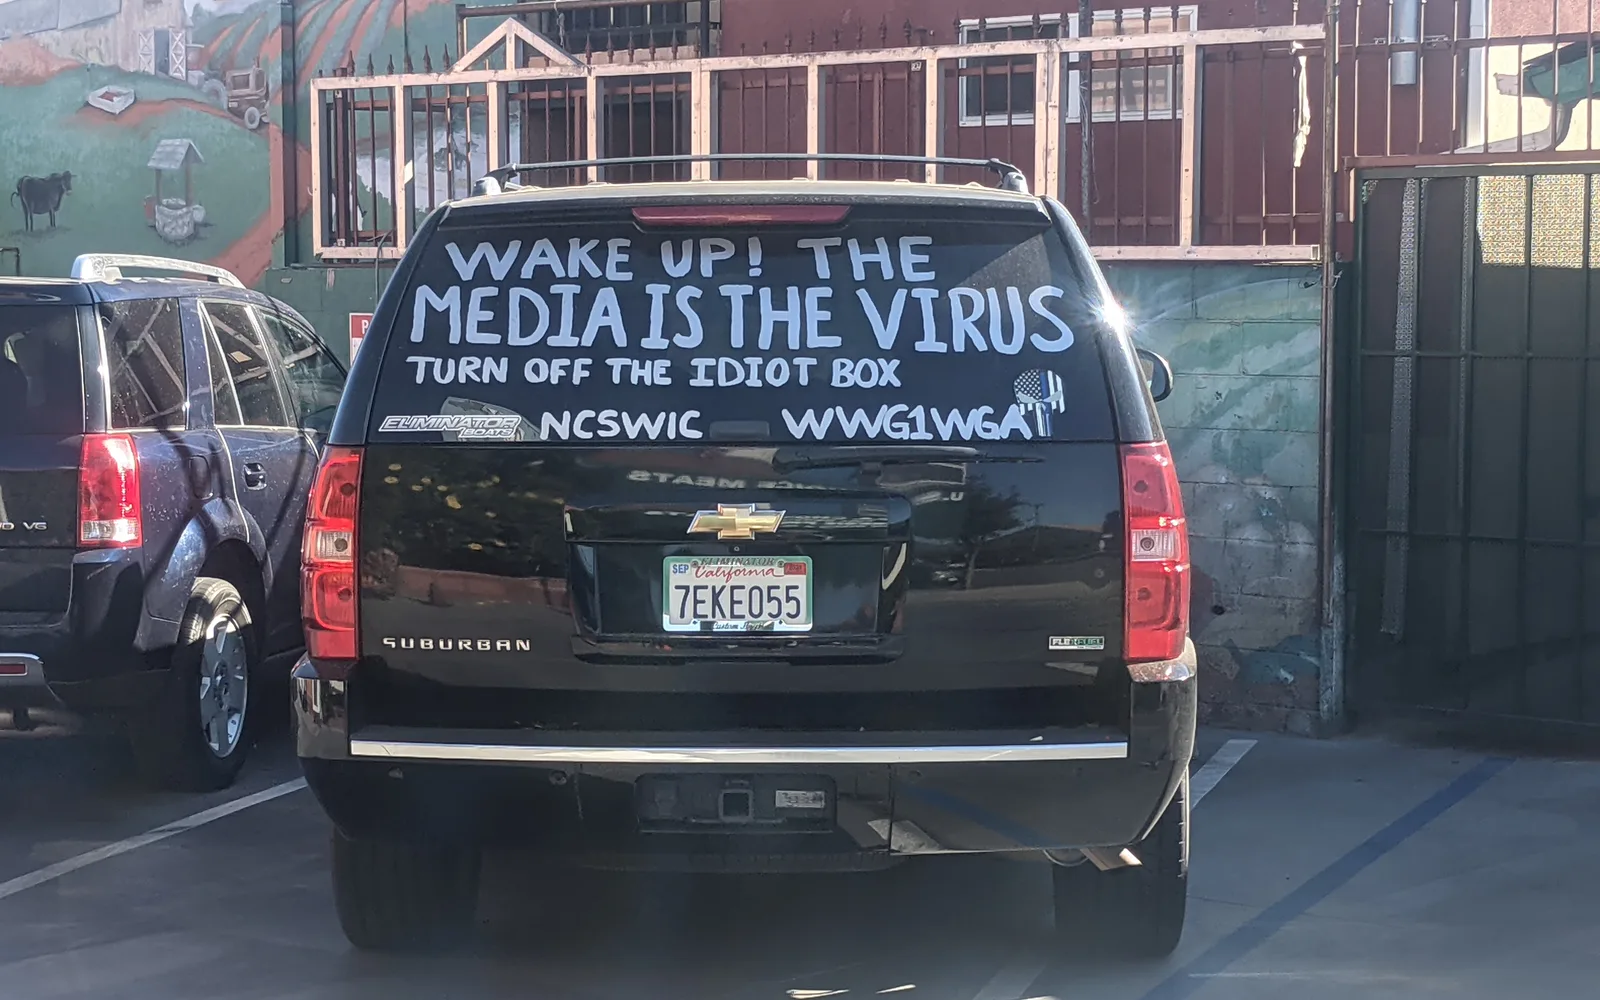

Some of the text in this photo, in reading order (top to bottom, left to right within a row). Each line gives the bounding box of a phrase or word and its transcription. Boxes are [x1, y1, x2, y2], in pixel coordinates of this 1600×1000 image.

[445, 236, 936, 282] WAKE UP! THE
[410, 284, 1074, 355] MEDIA IS THE VIRUS
[406, 356, 901, 387] TURN OFF THE IDIOT BOX
[384, 416, 518, 428] ELIMINATOR
[540, 410, 703, 440] NCSWIC
[782, 404, 1032, 441] WWG1WGA
[463, 428, 514, 436] BOATS
[23, 521, 47, 530] V6
[672, 564, 689, 574] SEP
[700, 557, 775, 566] ELIMINATOR
[695, 566, 785, 583] California
[674, 585, 801, 619] 7EKE055
[382, 637, 531, 651] SUBURBAN
